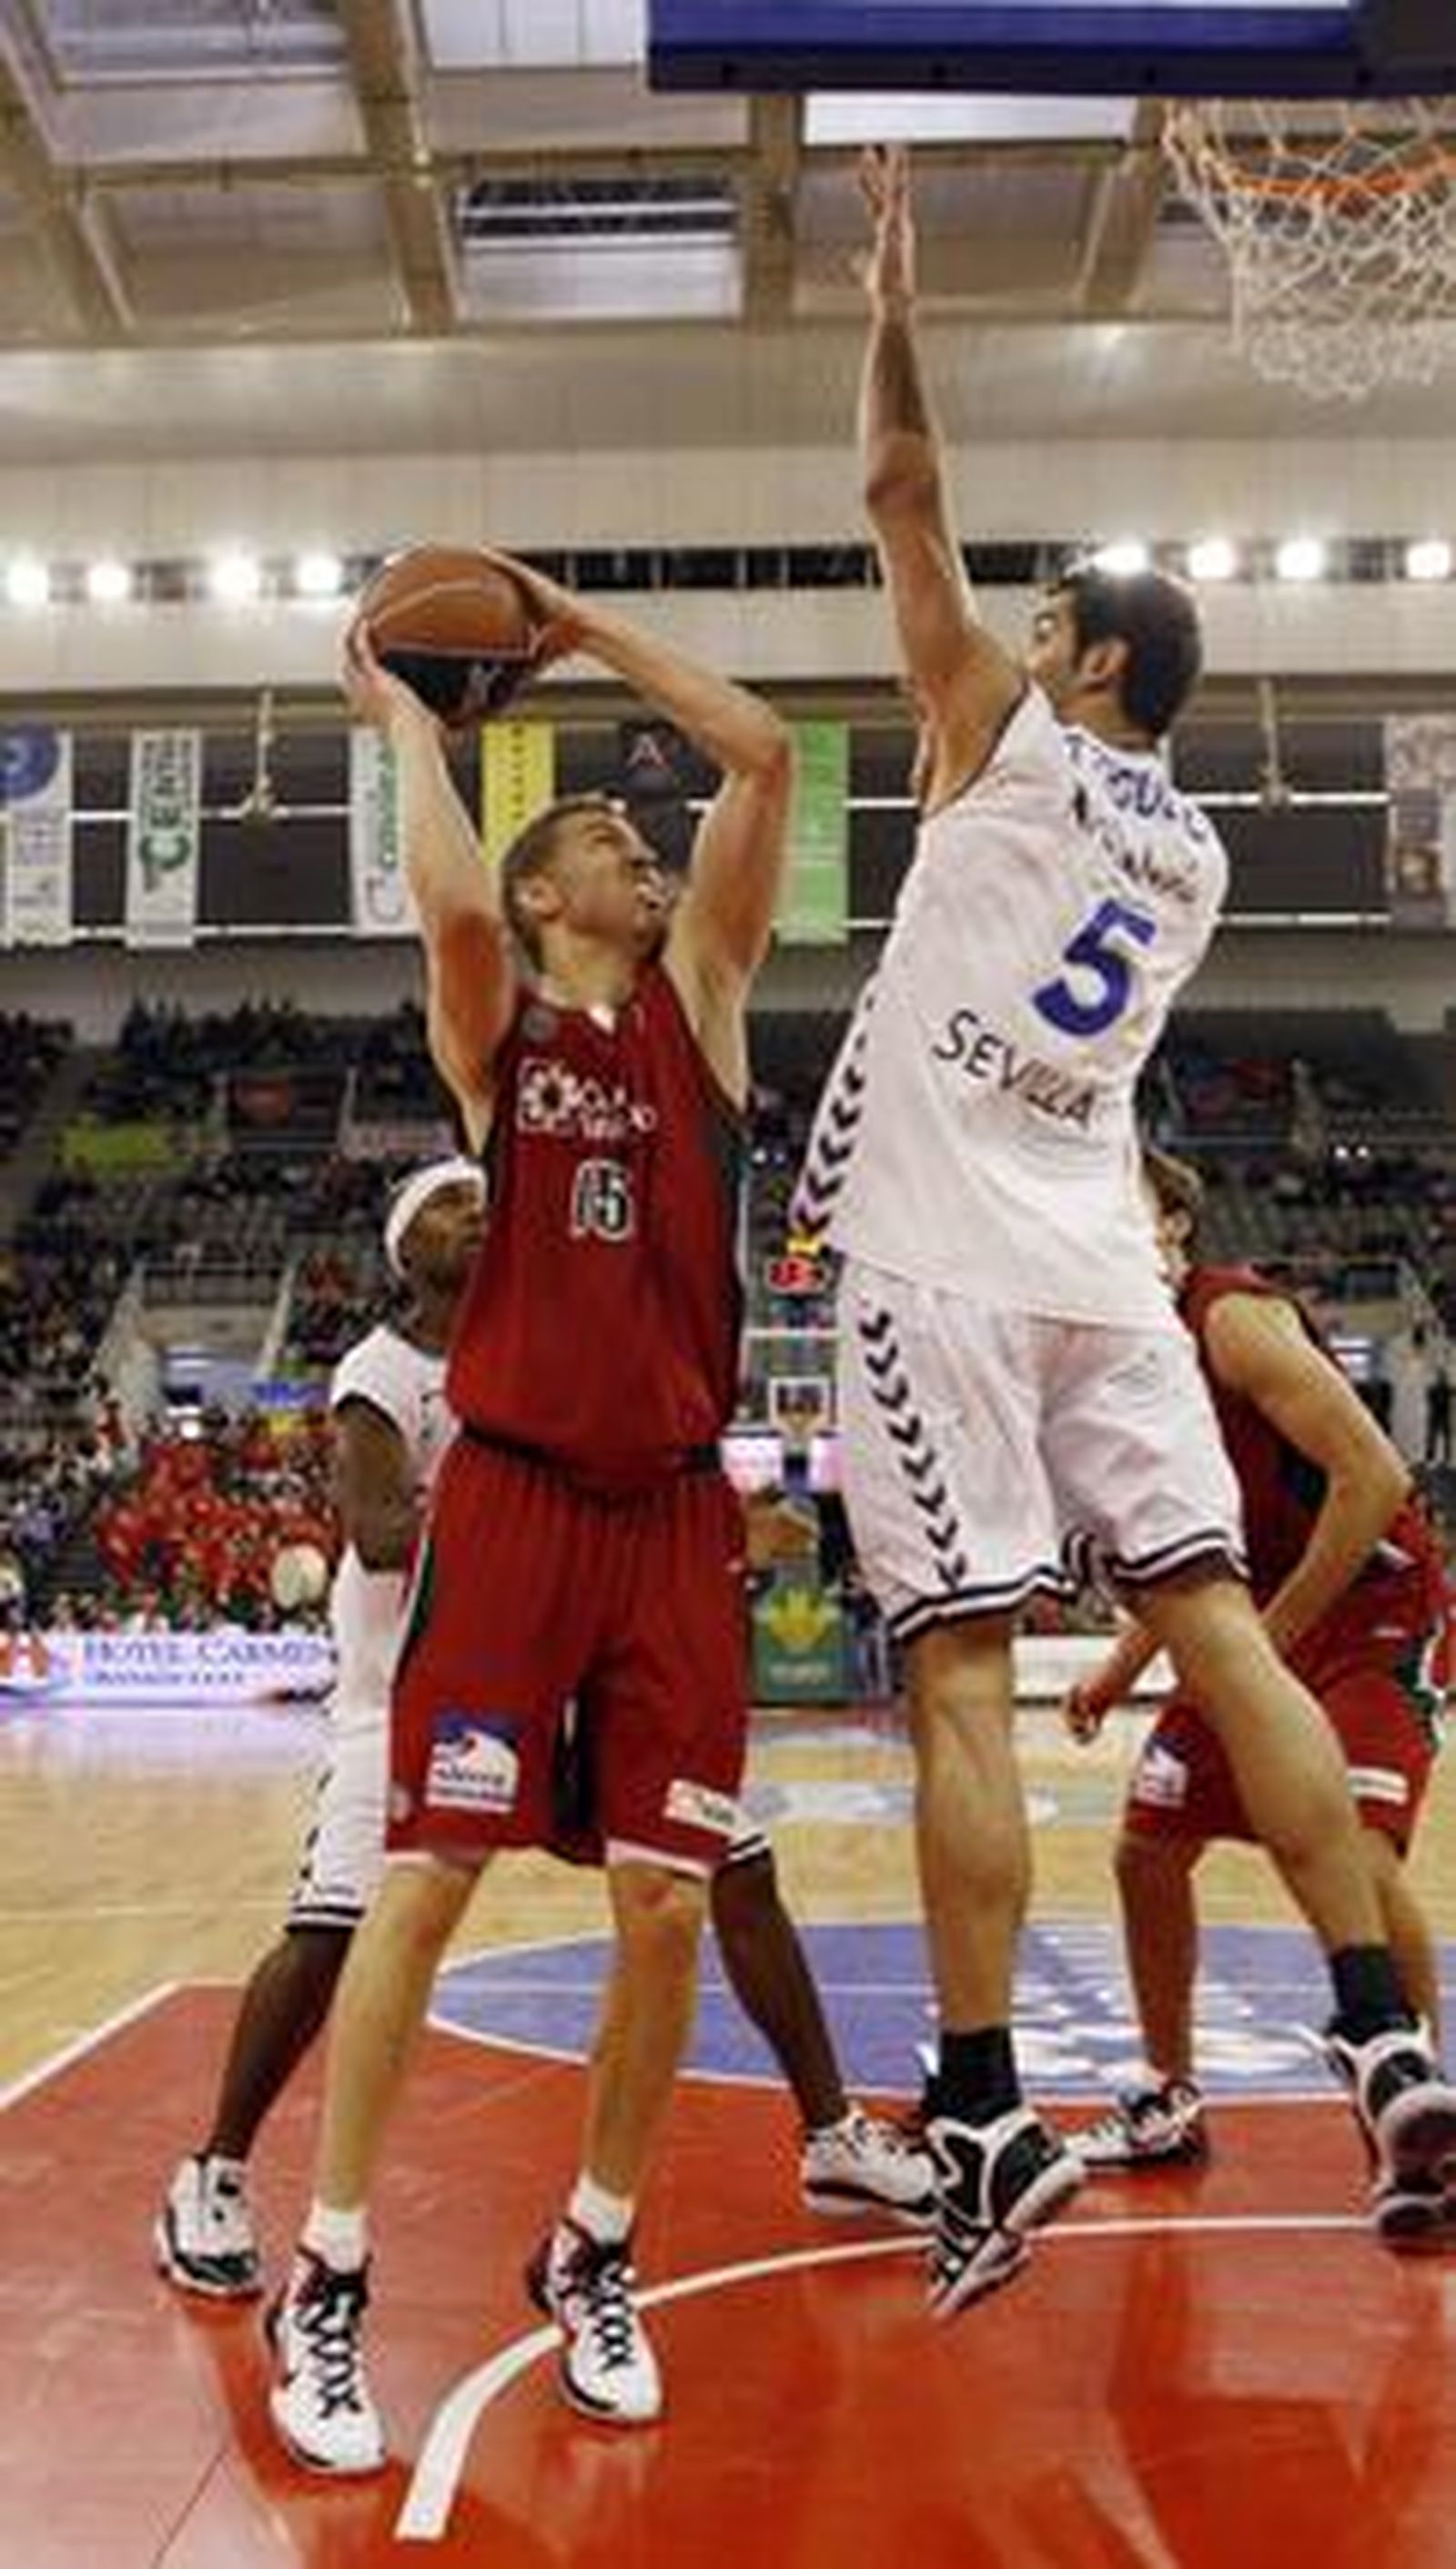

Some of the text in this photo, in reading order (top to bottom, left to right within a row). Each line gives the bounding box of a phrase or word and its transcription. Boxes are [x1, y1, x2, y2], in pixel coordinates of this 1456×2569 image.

[1033, 896, 1156, 1037] 5
[933, 1008, 1093, 1128] SEVILLA
[571, 1158, 634, 1240] 15
[84, 1638, 186, 1665] HOTEL
